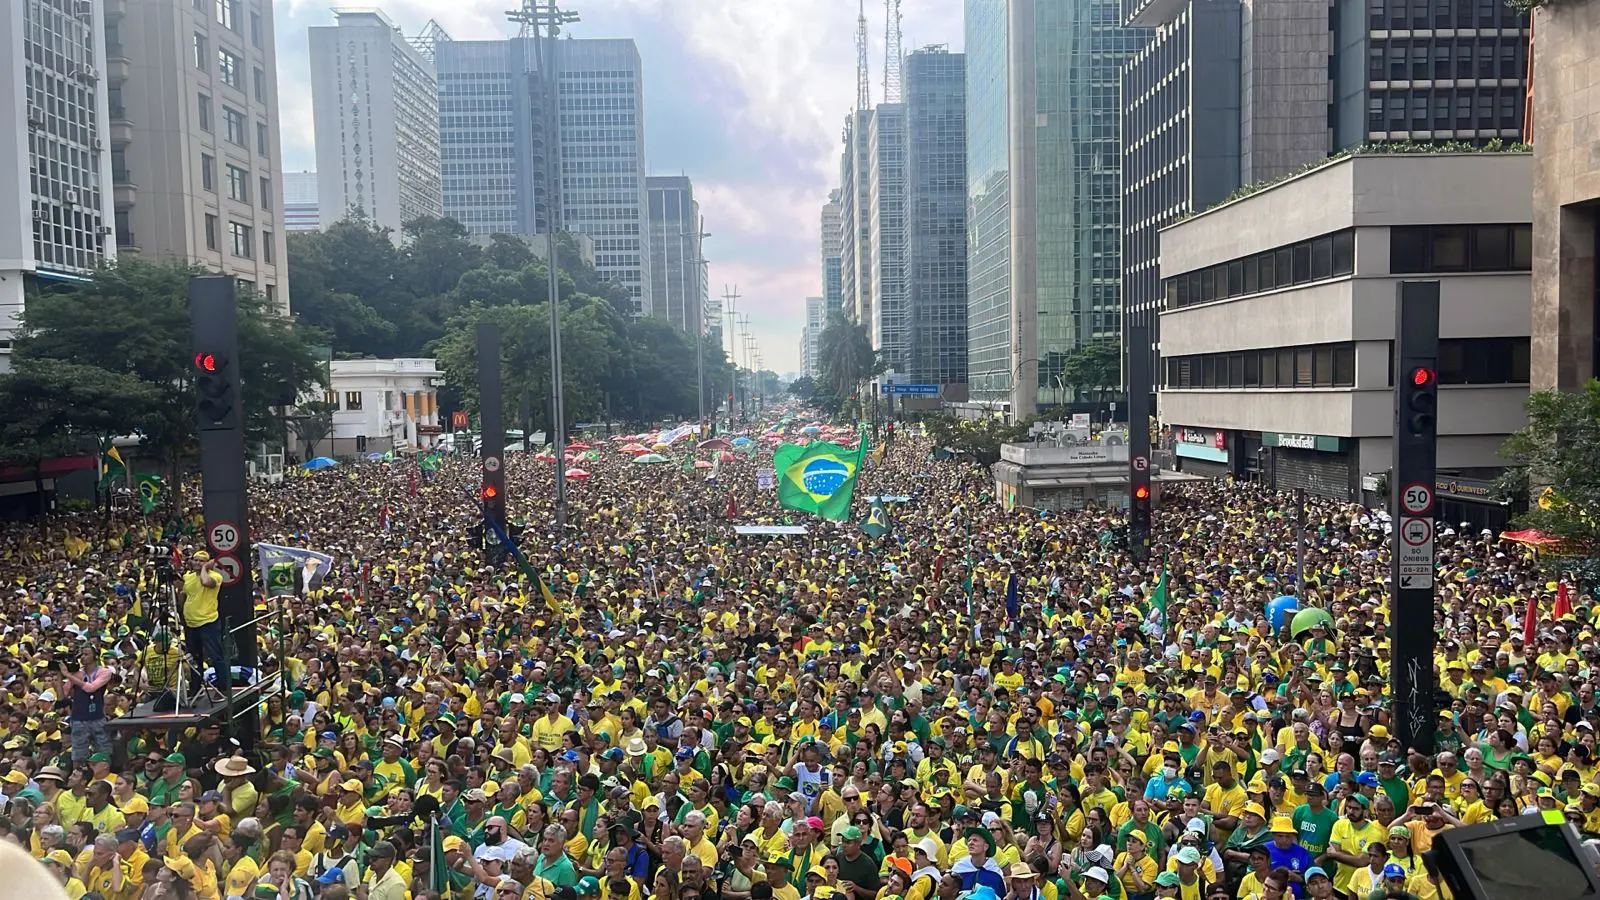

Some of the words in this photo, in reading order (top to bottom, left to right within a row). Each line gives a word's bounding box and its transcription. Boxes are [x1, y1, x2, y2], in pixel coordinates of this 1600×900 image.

[1278, 434, 1315, 449] Brooksfield
[1406, 490, 1428, 504] 50
[214, 530, 234, 542] 50
[1301, 821, 1316, 832] DEUS
